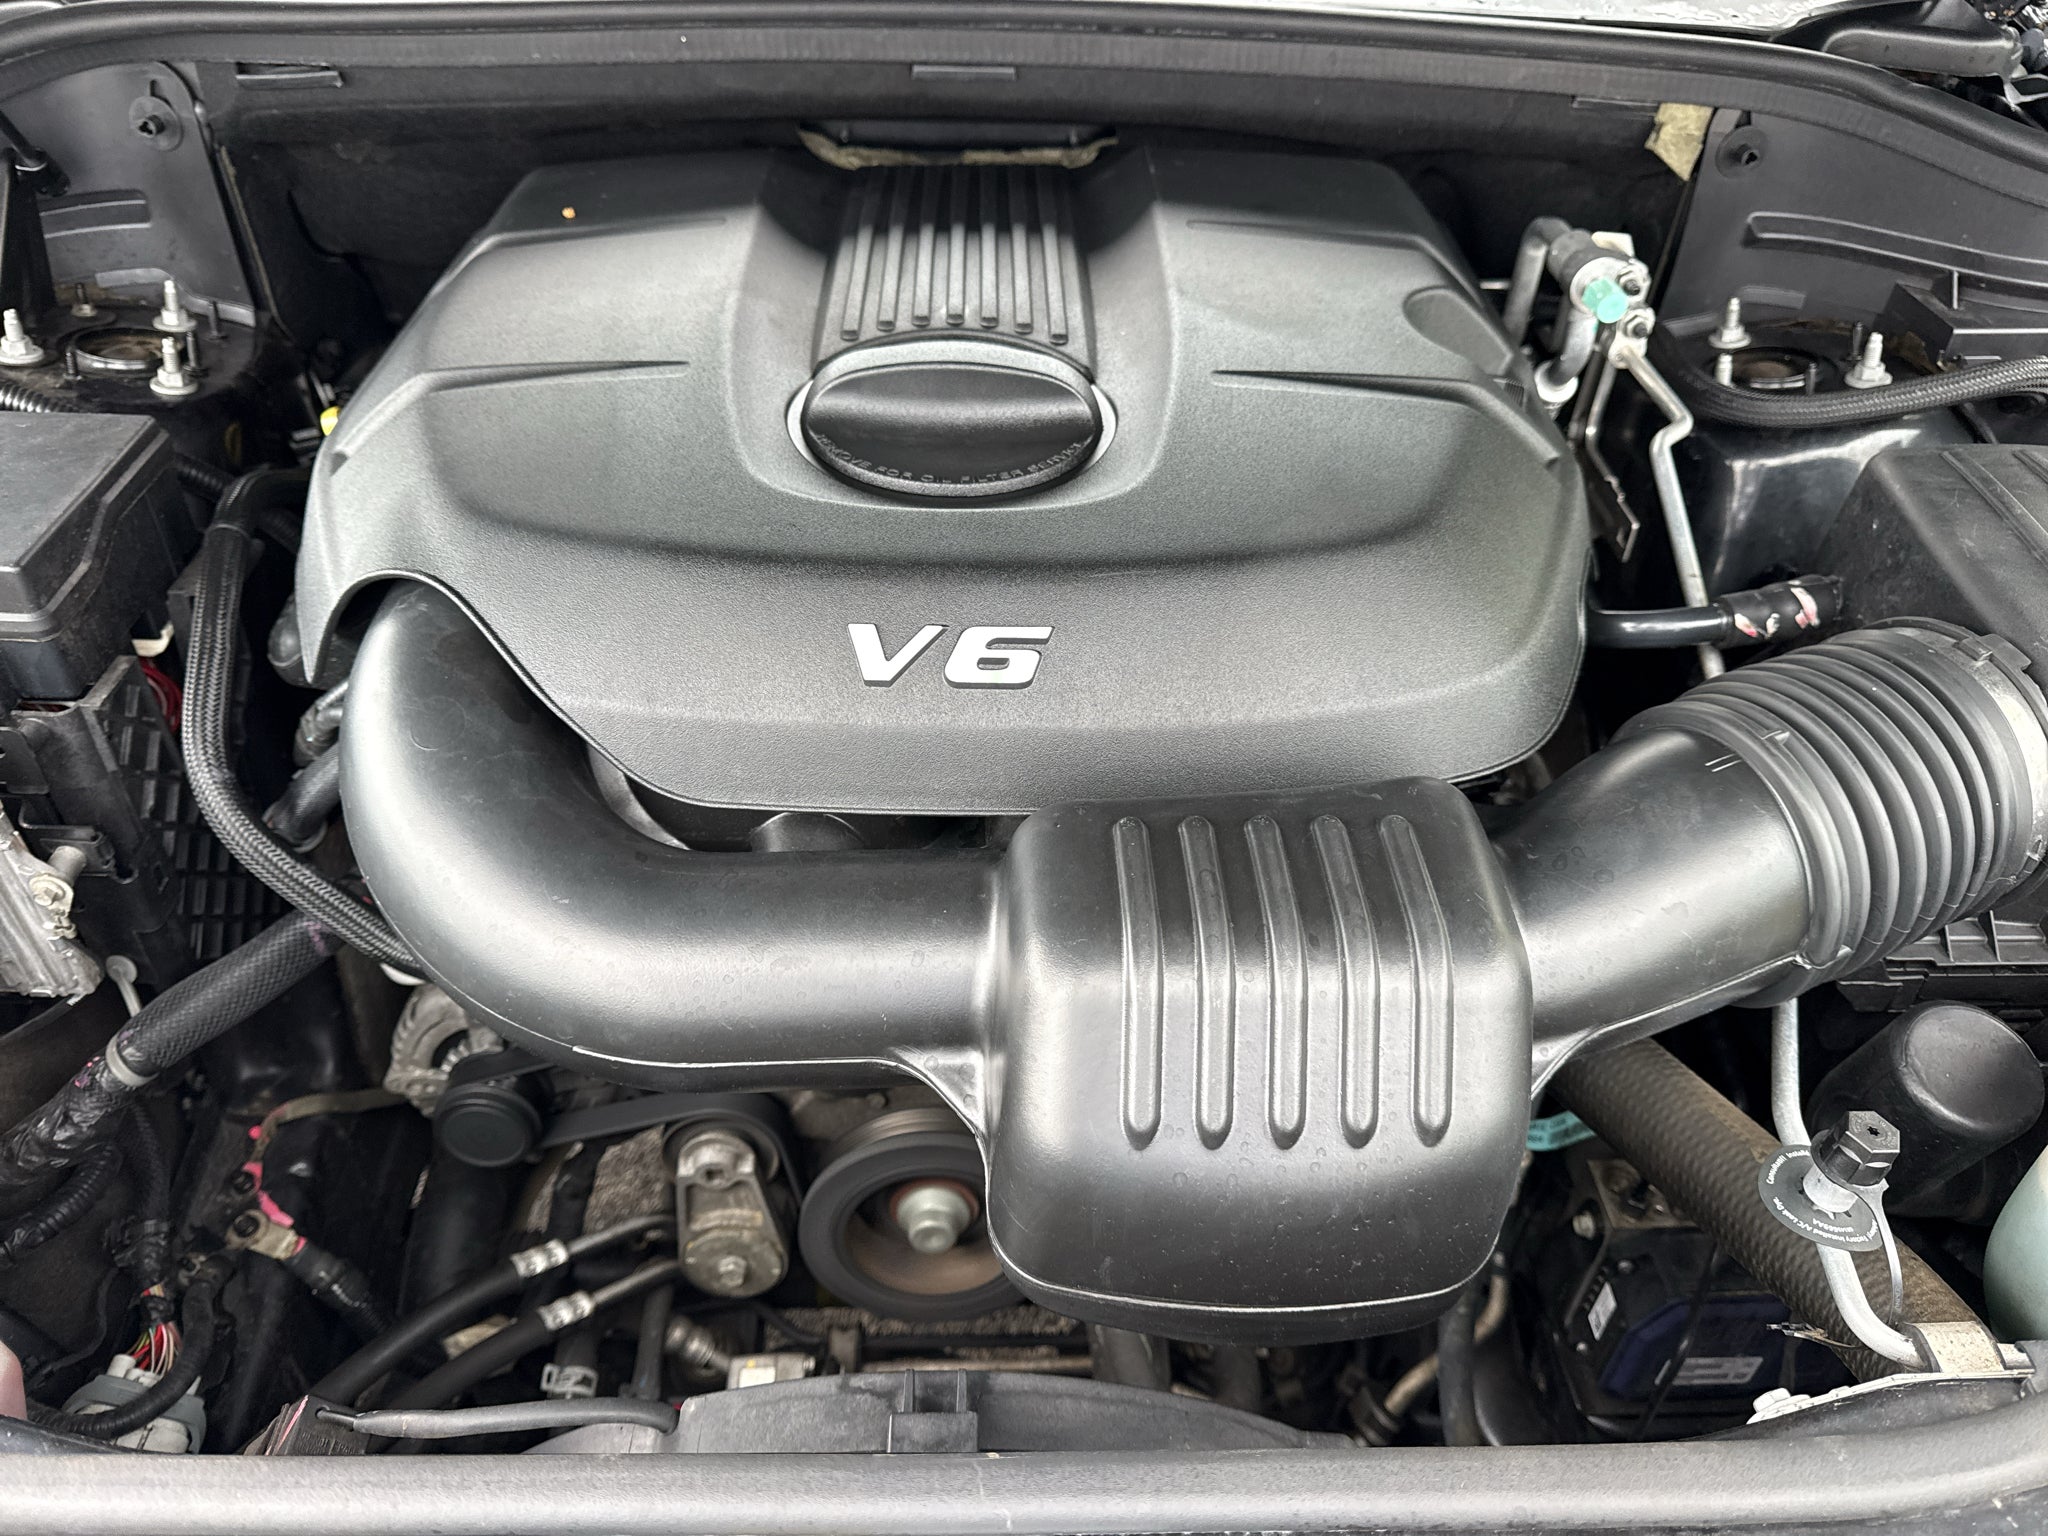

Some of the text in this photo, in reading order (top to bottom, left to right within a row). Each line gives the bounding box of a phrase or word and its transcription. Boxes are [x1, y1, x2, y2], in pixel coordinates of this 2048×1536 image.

[875, 466, 913, 480] FOR
[847, 623, 1056, 689] V6
[1782, 1209, 1798, 1224] Leak
[1797, 1221, 1812, 1231] A/C
